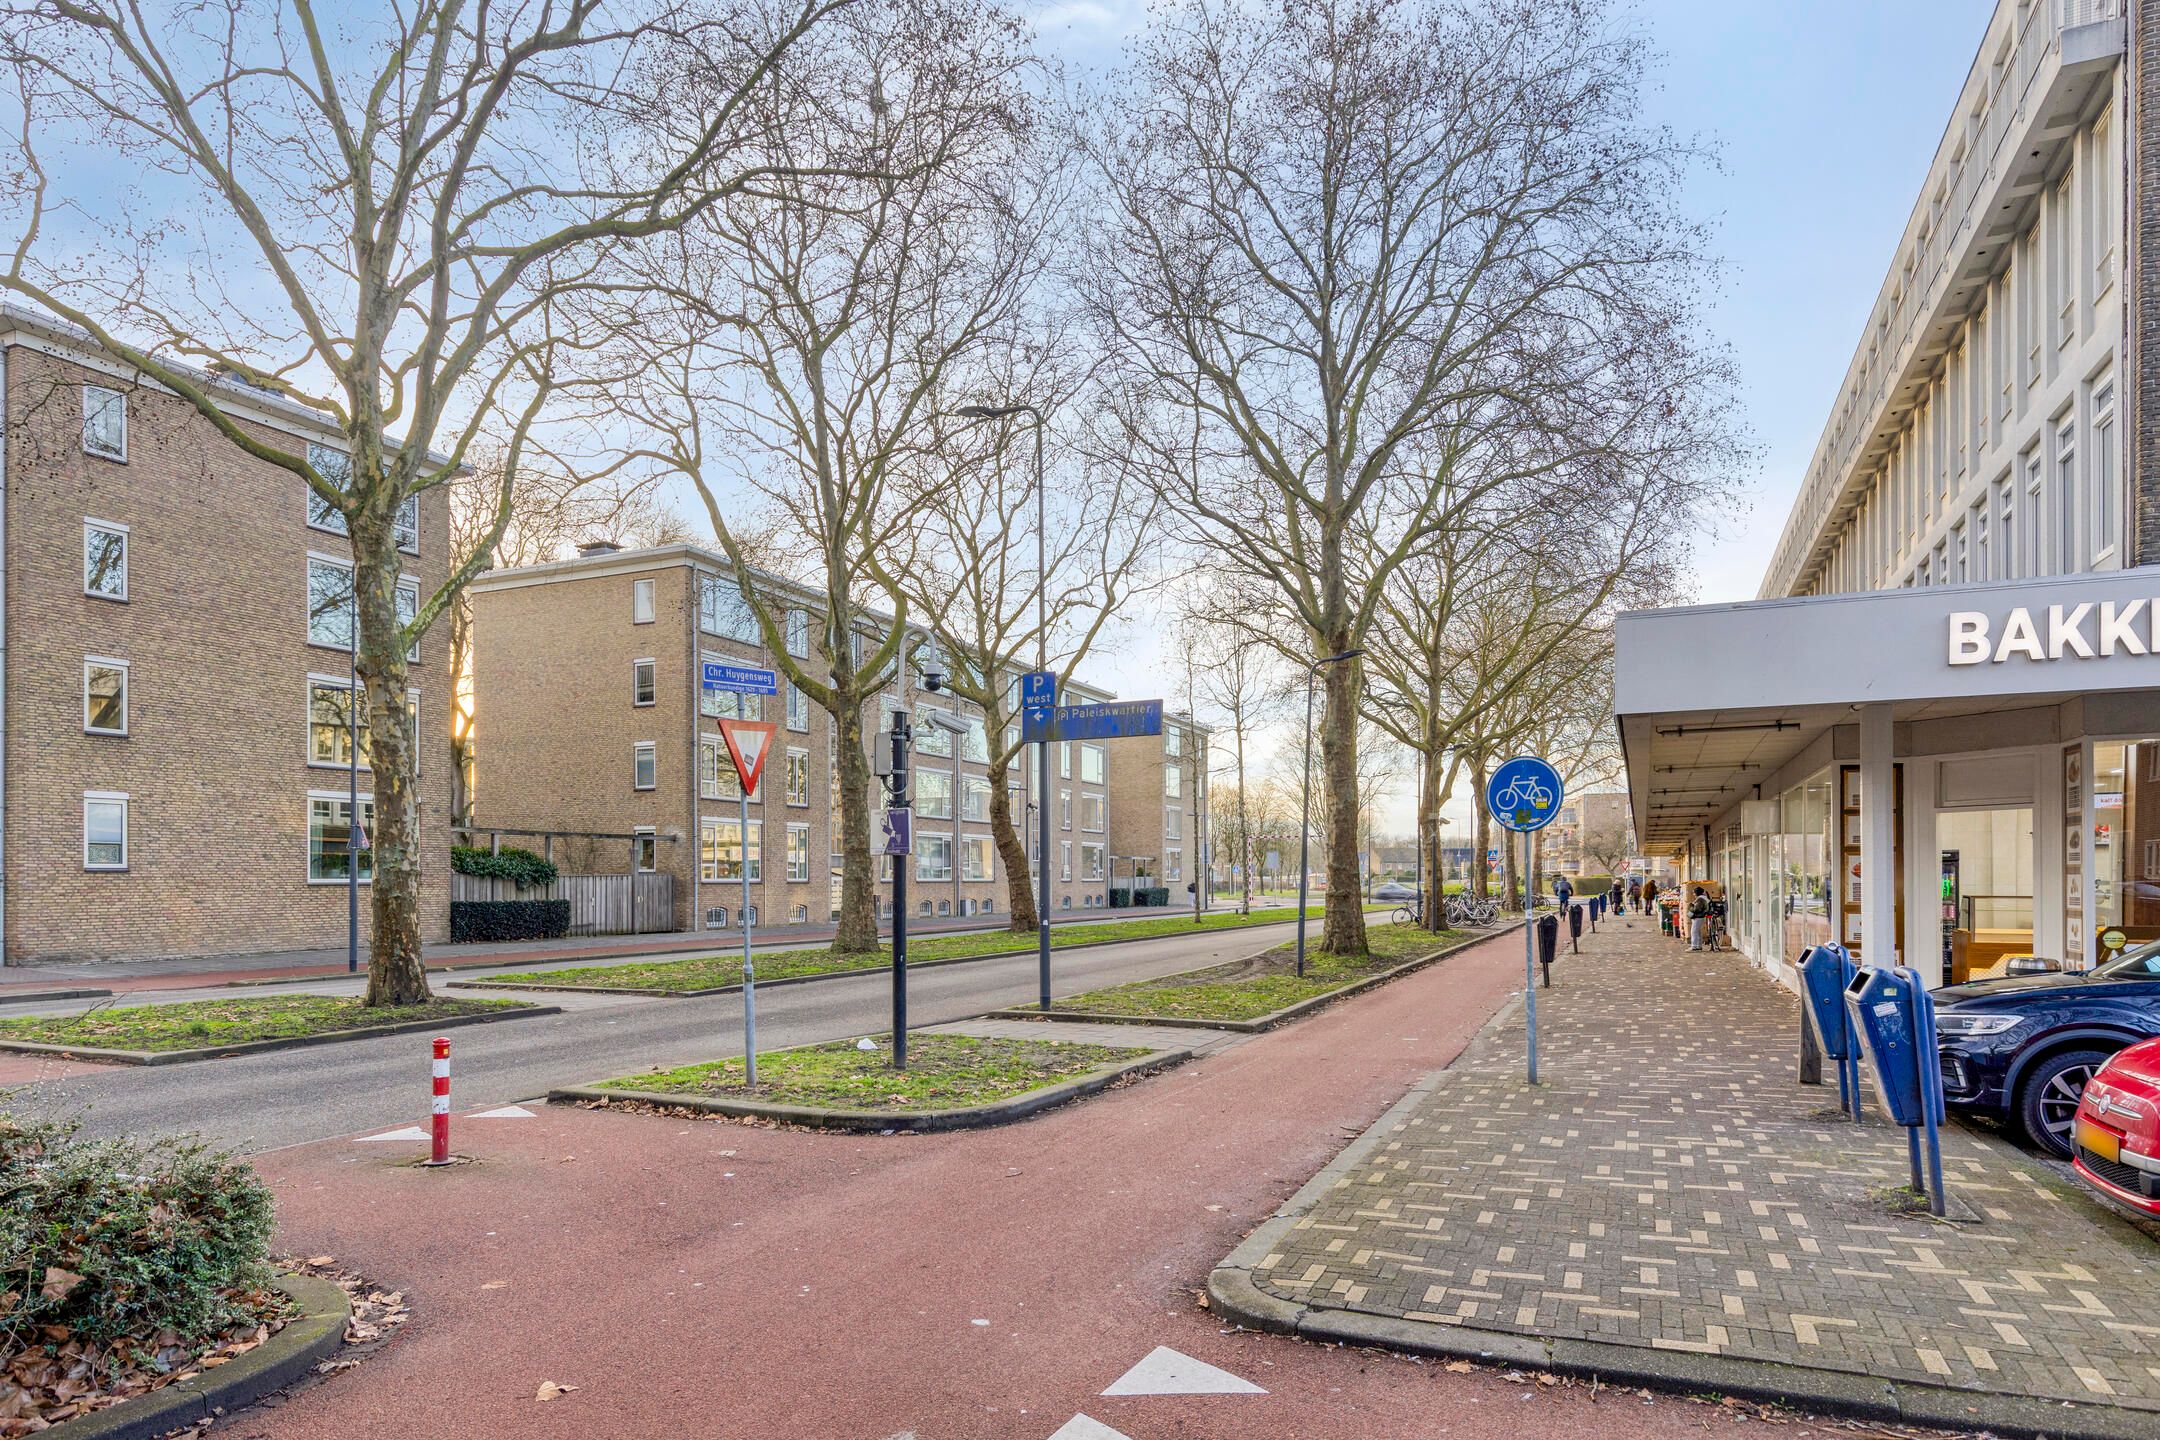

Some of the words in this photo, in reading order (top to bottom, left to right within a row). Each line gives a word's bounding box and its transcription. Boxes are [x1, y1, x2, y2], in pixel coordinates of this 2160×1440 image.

[1947, 598, 2160, 666] BAKK
[708, 666, 724, 678] Chr.
[726, 668, 772, 685] Huygensweg
[1033, 676, 1044, 693] P
[1026, 694, 1050, 704] west
[1072, 703, 1152, 719] Paleiskwartier
